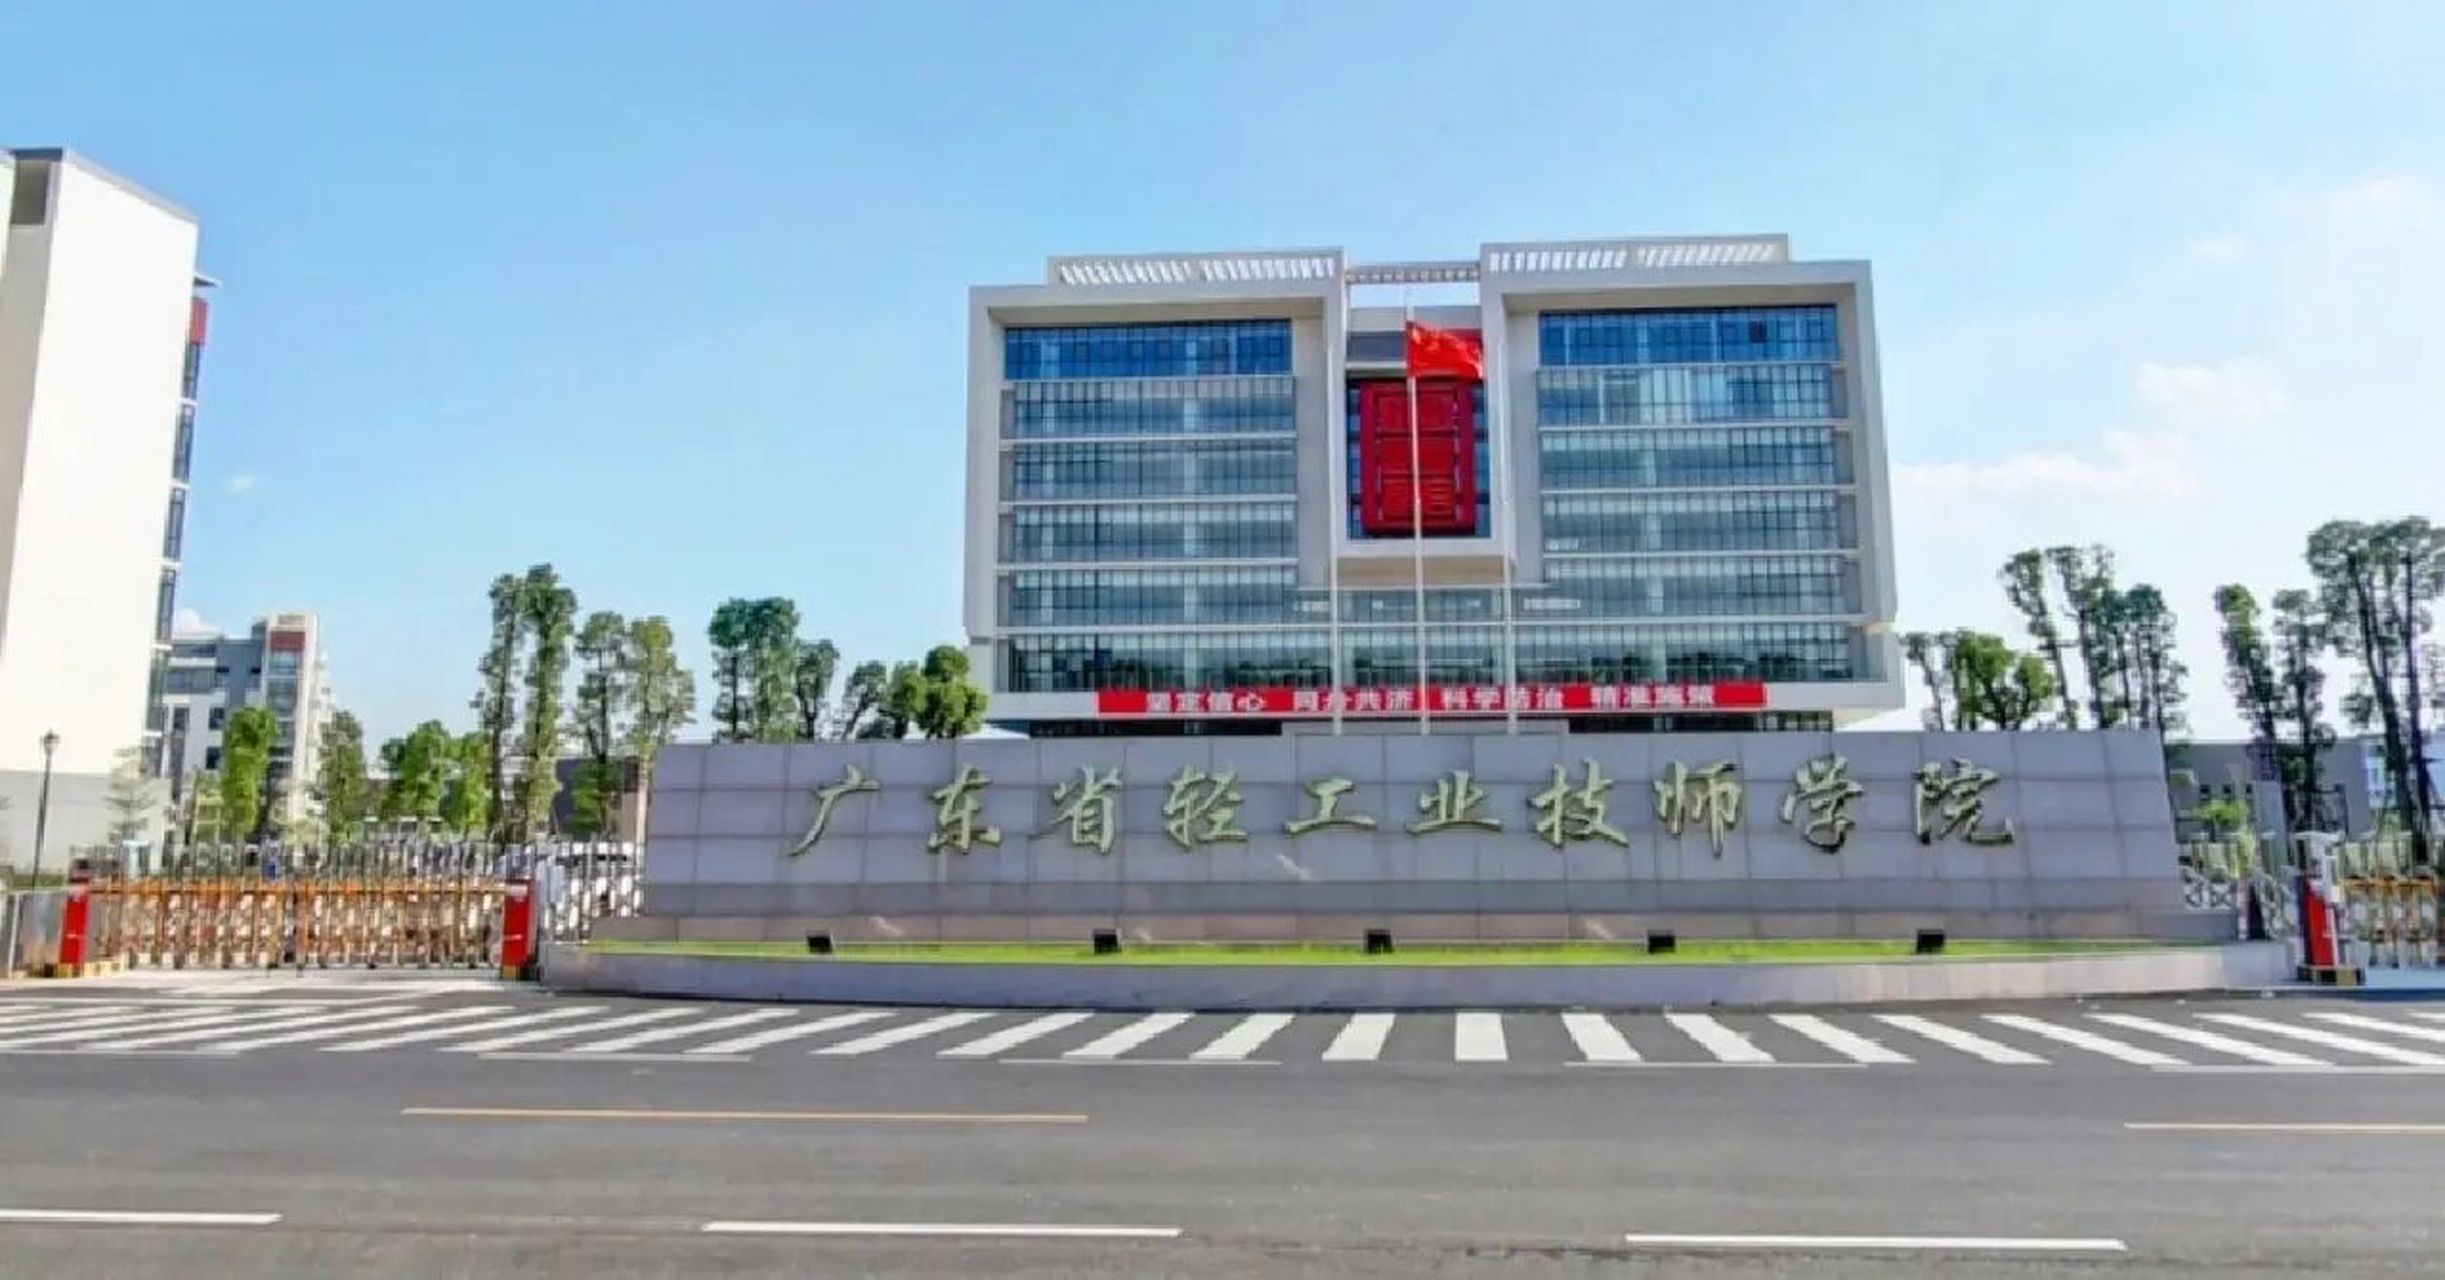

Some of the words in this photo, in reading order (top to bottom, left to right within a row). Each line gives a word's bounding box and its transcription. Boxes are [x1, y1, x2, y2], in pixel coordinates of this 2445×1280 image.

[788, 754, 2018, 858] 广东省轻工业技师学院
